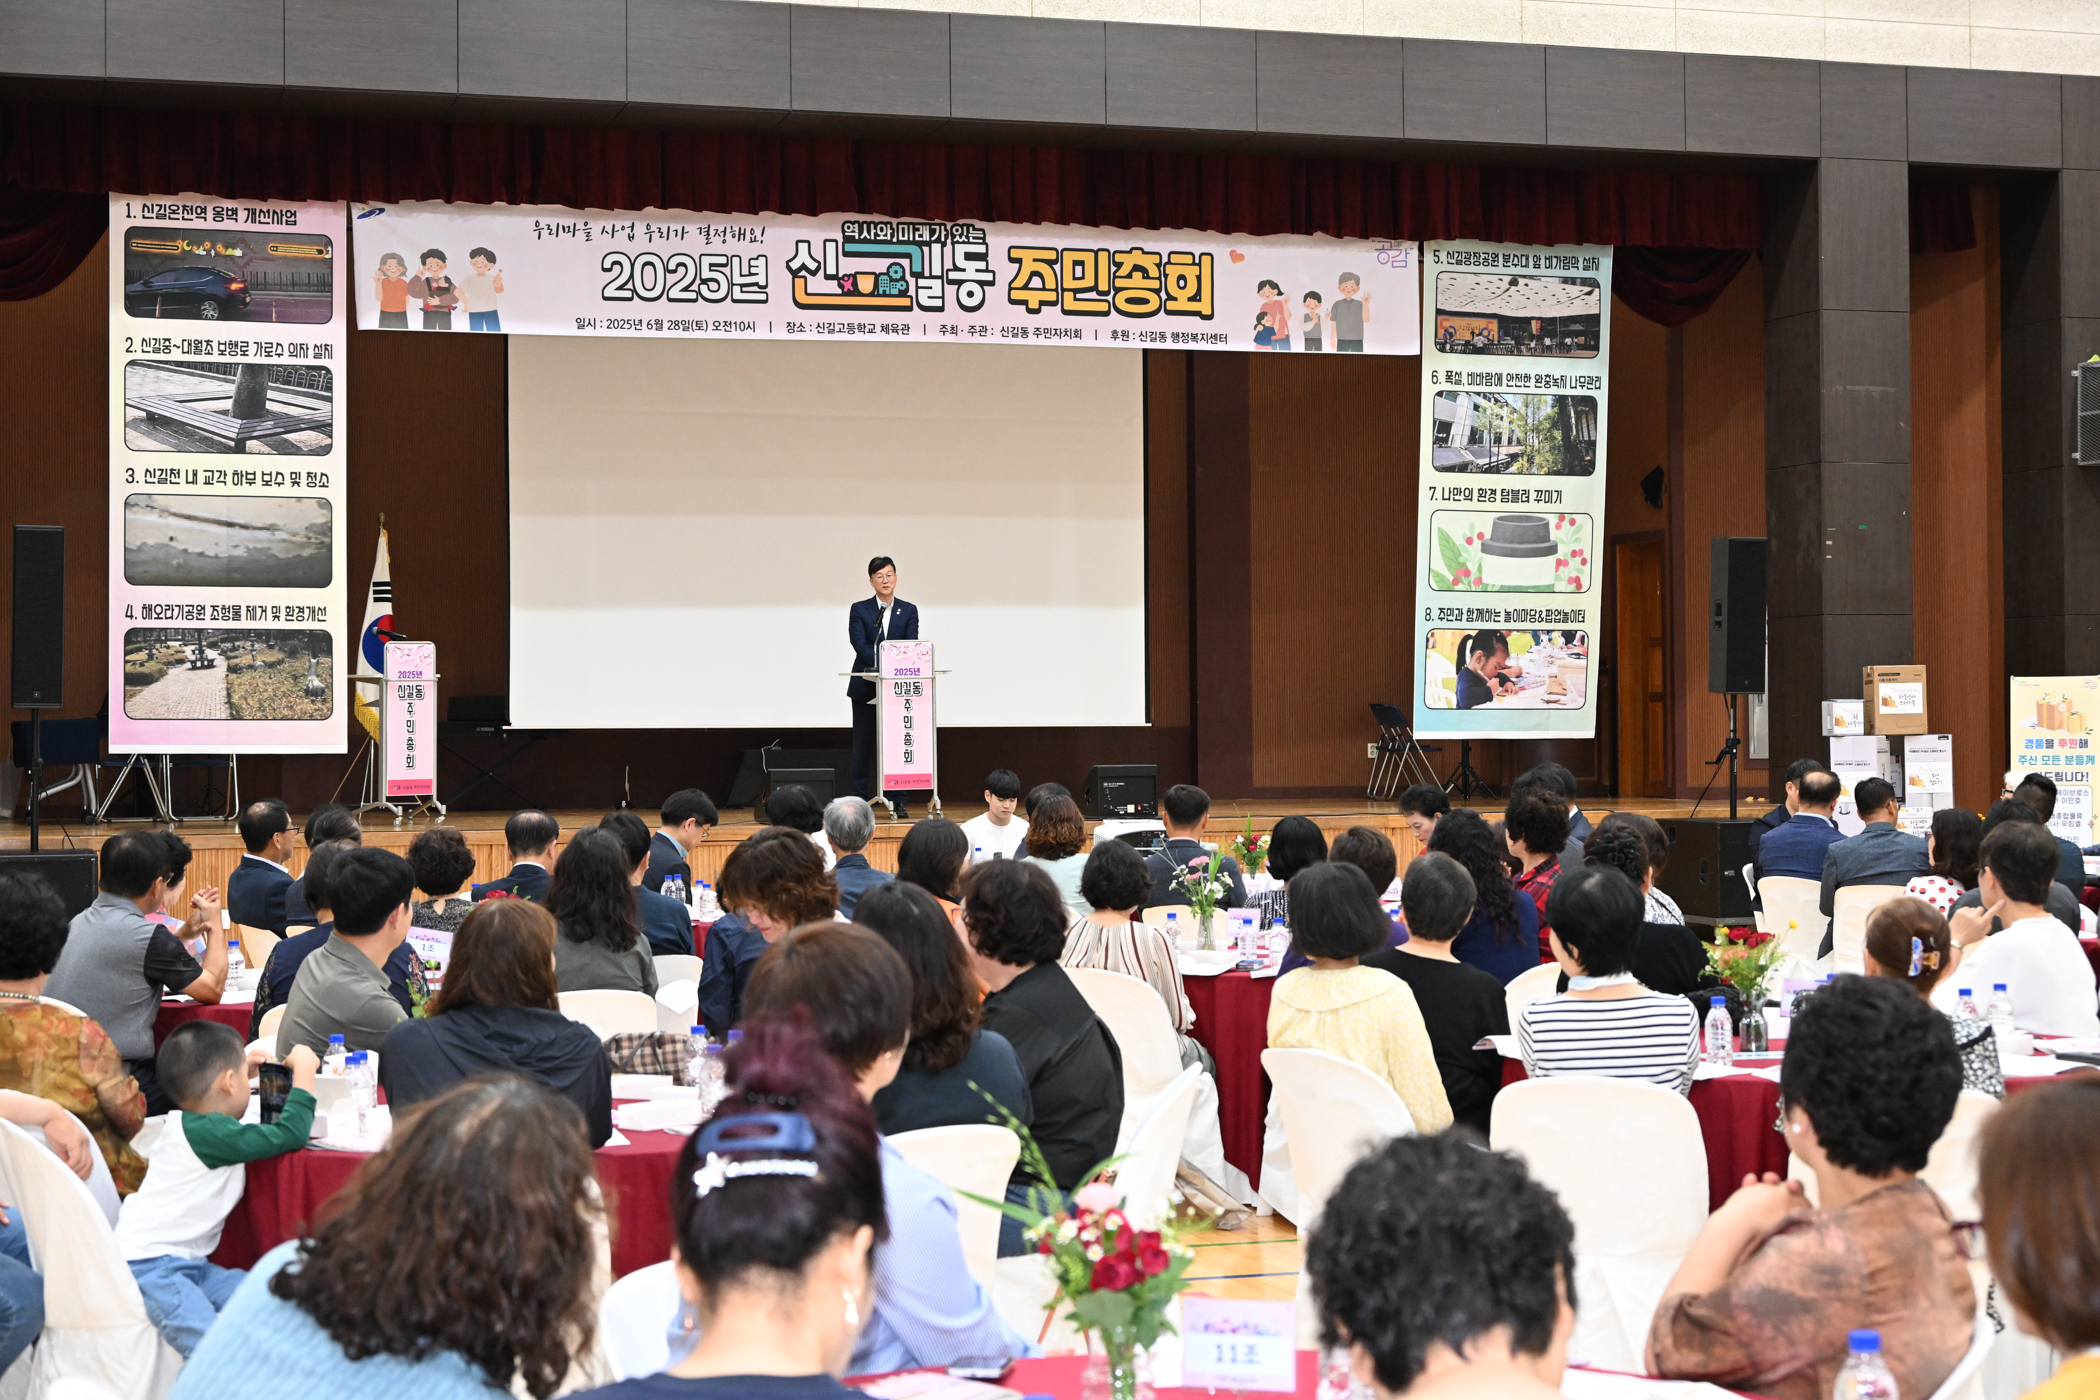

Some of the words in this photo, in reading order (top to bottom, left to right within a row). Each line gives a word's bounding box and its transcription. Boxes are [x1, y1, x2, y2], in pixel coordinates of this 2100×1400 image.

[125, 202, 137, 218] 1.
[141, 203, 208, 222] 신길온천역
[212, 206, 239, 223] 옹벽
[243, 208, 298, 226] 개선사업
[532, 220, 594, 242] 우리마을
[600, 222, 636, 242] 사업
[644, 223, 689, 244] 우리가
[696, 224, 767, 246] 결정해요!
[842, 222, 894, 241] 역사와
[897, 222, 947, 242] 미래가
[952, 222, 986, 243] 있는
[1433, 250, 1444, 264] 5.
[1446, 250, 1500, 268] 신길광장공원
[1502, 253, 1530, 270] 분수대
[1532, 254, 1542, 270] 앞
[1544, 254, 1580, 272] 비가림막
[1582, 256, 1600, 272] 설치
[600, 250, 770, 304] 2025년
[786, 239, 996, 312] 신길동
[1008, 245, 1215, 321] 주민총회
[575, 316, 596, 331] 일시
[606, 318, 644, 332] 2025년
[646, 318, 664, 332] 6월
[666, 318, 709, 333] 28일(토)
[711, 319, 756, 334] 오전10시
[785, 320, 807, 334] 장소
[814, 321, 877, 336] 신길고등학교
[880, 322, 911, 336] 체육관
[938, 324, 959, 338] 주최
[967, 325, 988, 338] 주관
[999, 326, 1030, 340] 신길동
[1032, 328, 1082, 341] 주민자치회
[1110, 329, 1131, 342] 후원
[1138, 330, 1168, 344] 신길동
[1170, 331, 1228, 346] 행정복지센터
[124, 336, 137, 354] 2.
[140, 337, 214, 356] 신길중~대월초
[217, 339, 250, 357] 보행로
[252, 341, 284, 358] 가로수
[288, 342, 310, 358] 의자
[312, 343, 334, 360] 설치
[1431, 370, 1442, 384] 6.
[1444, 370, 1465, 388] 폭설,
[1466, 371, 1503, 388] 비바람에
[1506, 372, 1532, 388] 안전한
[1534, 374, 1568, 390] 완충녹지
[1569, 375, 1602, 391] 나무관리
[125, 468, 139, 484] 3.
[144, 468, 181, 486] 신길천
[185, 469, 198, 486] 내
[202, 469, 228, 486] 교각
[232, 470, 256, 487] 하부
[261, 471, 285, 488] 보수
[290, 472, 302, 488] 및
[306, 471, 330, 488] 청소
[1428, 486, 1438, 502] 7.
[1442, 486, 1474, 502] 나만의
[1476, 487, 1498, 504] 환경
[1500, 488, 1530, 504] 텀블러
[1533, 490, 1562, 505] 꾸미기
[125, 604, 138, 620] 4.
[142, 604, 206, 621] 해오라기공원
[210, 604, 242, 622] 조형물
[245, 604, 268, 622] 제거
[271, 605, 281, 622] 및
[284, 606, 327, 622] 환경개선
[1424, 608, 1434, 622] 8.
[1437, 606, 1464, 622] 주민과
[1466, 608, 1502, 624] 함께하는
[1504, 608, 1585, 624] 놀이마당&팝업놀이터
[398, 670, 423, 679] 2025년
[894, 668, 921, 676] 2025년
[397, 684, 426, 700] 신길동
[894, 681, 924, 697] 신길동
[406, 702, 416, 770] 주민총회
[903, 698, 915, 765] 주민총회
[2024, 738, 2054, 750] 경품을
[2058, 738, 2088, 749] 후원해
[2018, 754, 2038, 766] 주신
[2041, 754, 2062, 766] 모든
[2064, 754, 2096, 766] 분들께
[1214, 1344, 1262, 1365] 11조
